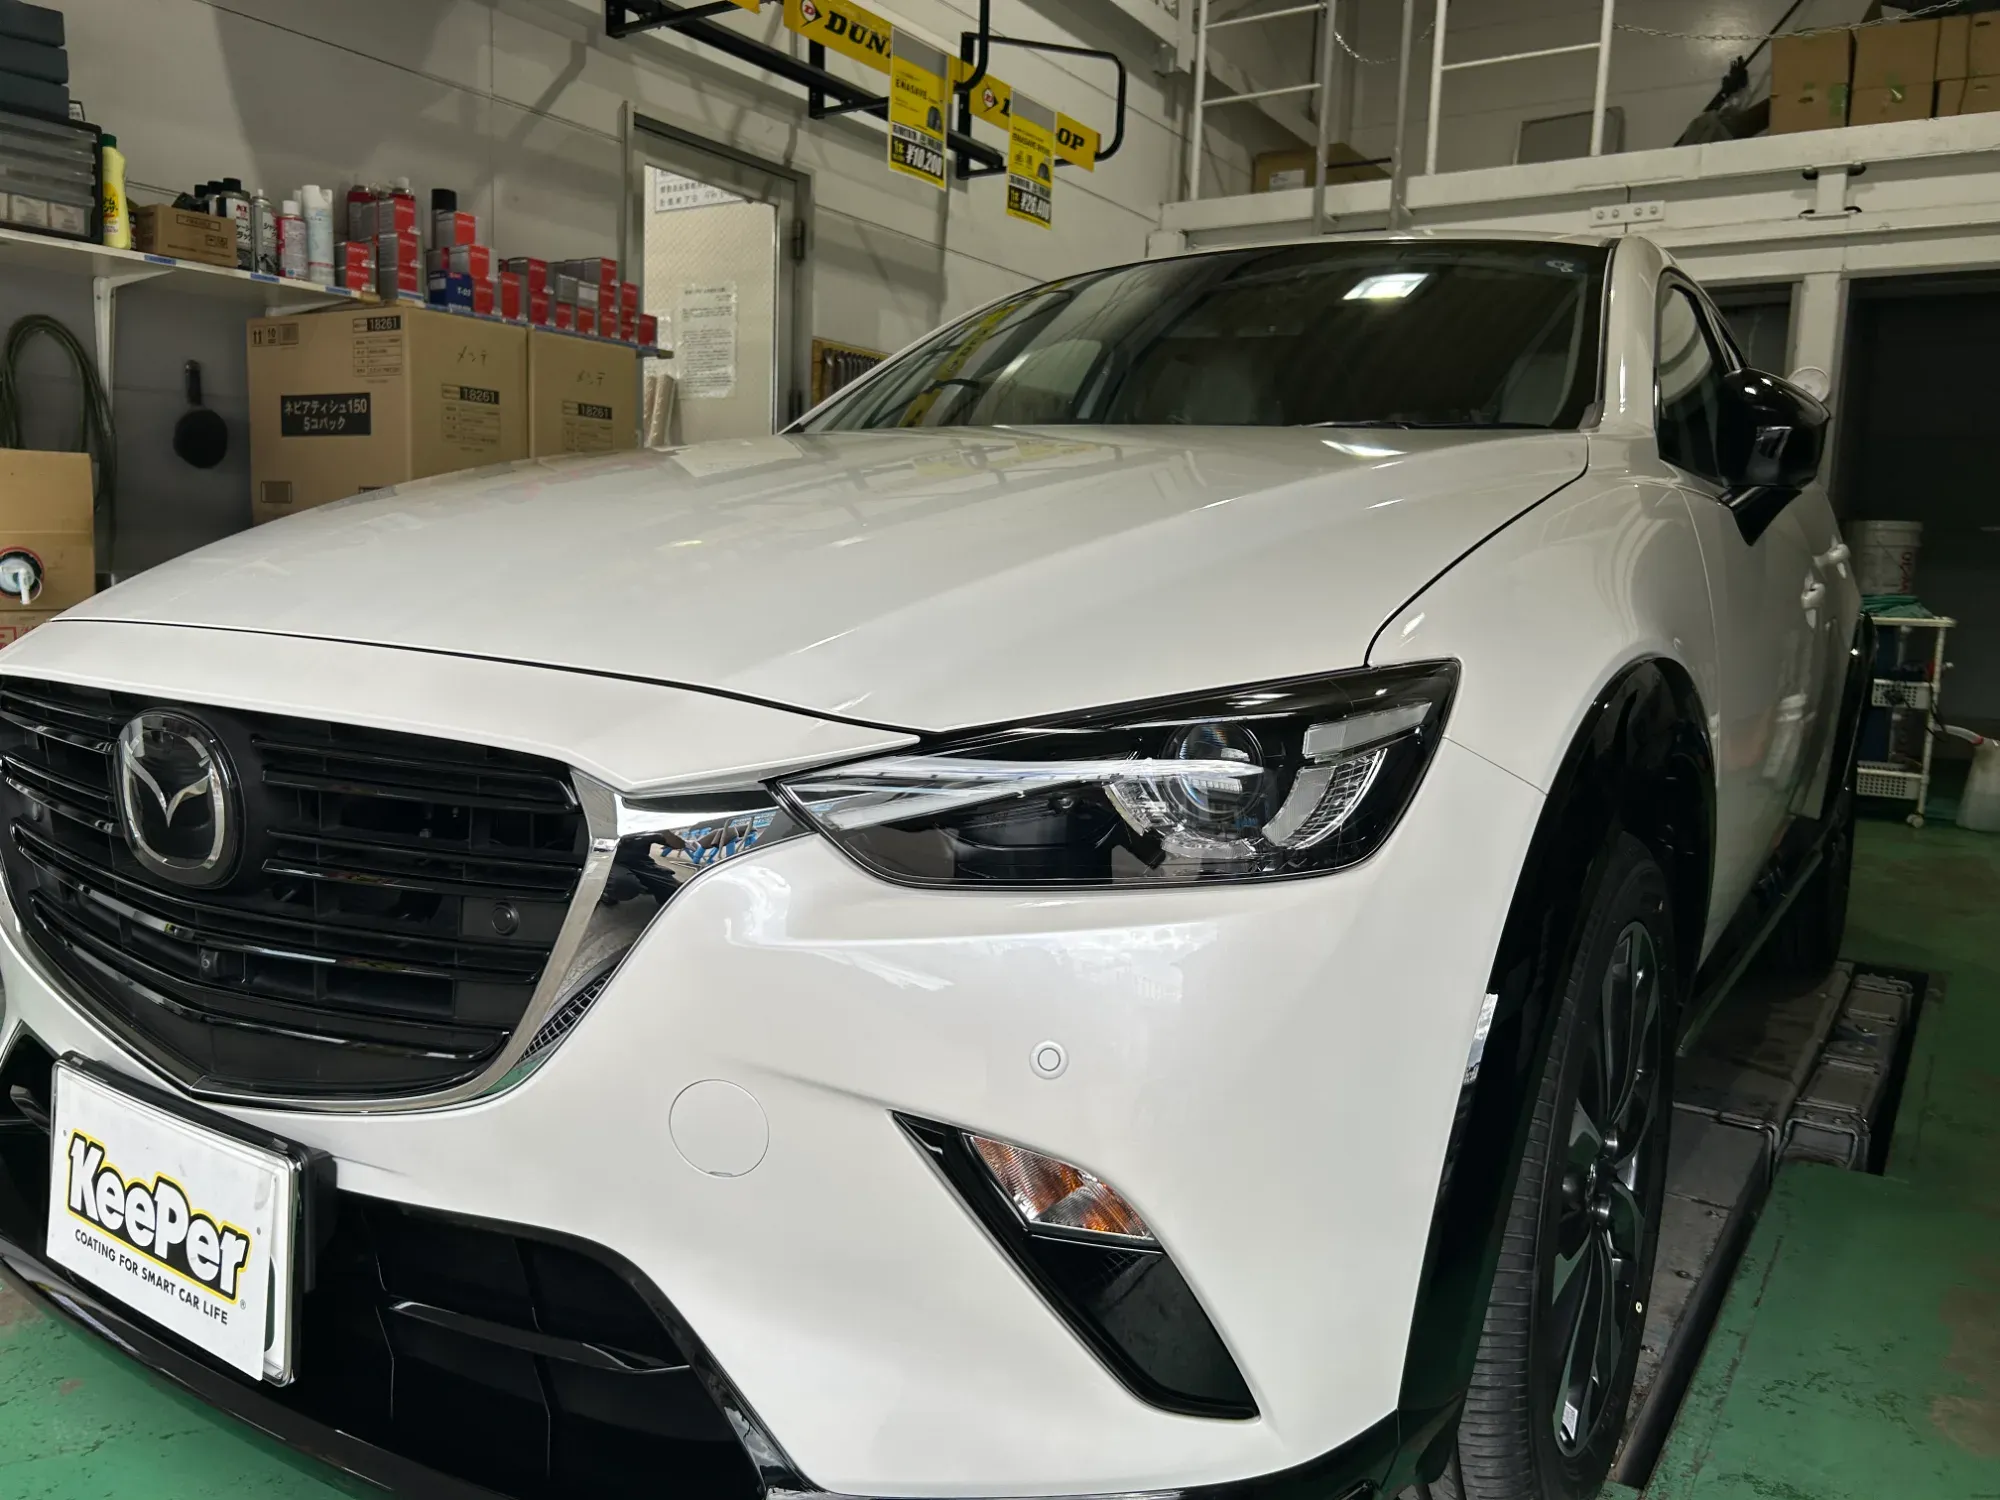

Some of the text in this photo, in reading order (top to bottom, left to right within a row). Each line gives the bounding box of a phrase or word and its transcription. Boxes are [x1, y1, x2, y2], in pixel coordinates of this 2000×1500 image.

[825, 10, 892, 59] DUN
[369, 318, 397, 330] 18261
[463, 387, 497, 403] 18261
[581, 405, 610, 418] 18261
[303, 416, 346, 431] 5コパック
[68, 1131, 250, 1301] KeePer
[74, 1228, 228, 1326] COATING FOR SMART CAR LIFE
